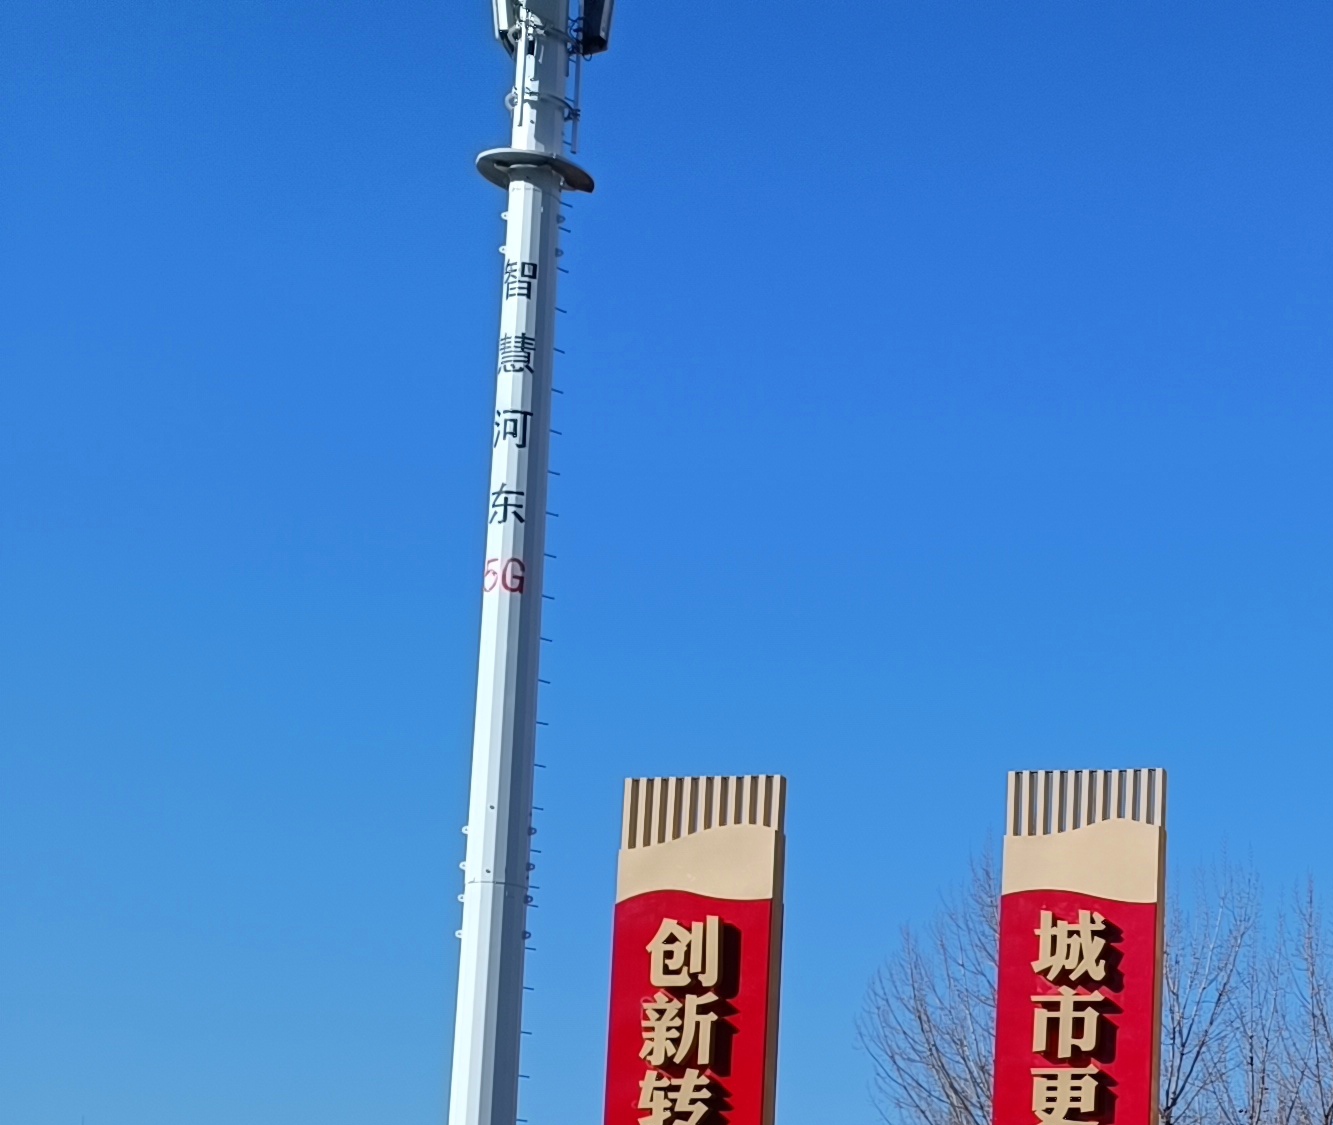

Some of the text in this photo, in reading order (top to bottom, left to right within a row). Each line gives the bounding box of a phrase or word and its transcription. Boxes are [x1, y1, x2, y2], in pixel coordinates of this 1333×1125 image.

[489, 258, 537, 524] 智慧河东
[482, 557, 526, 594] 5G
